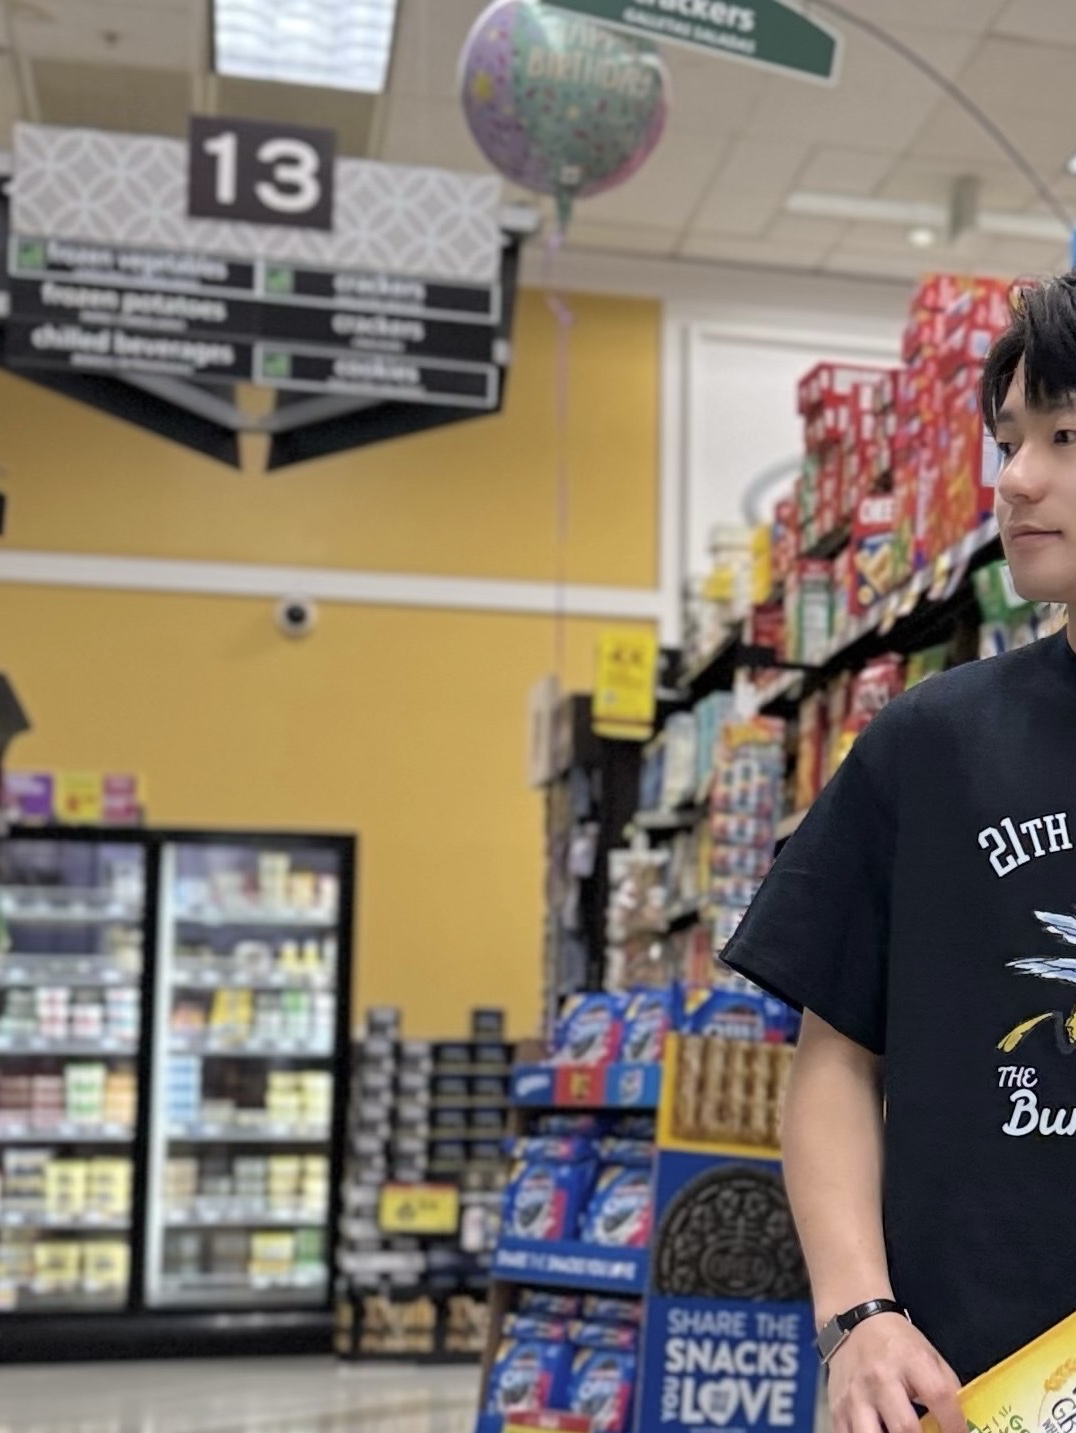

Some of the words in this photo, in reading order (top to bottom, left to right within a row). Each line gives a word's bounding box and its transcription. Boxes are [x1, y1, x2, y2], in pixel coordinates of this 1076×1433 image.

[204, 130, 322, 214] 13
[977, 812, 1073, 877] 21TH
[997, 1065, 1039, 1089] THE
[667, 1307, 748, 1338] SHARE
[754, 1312, 800, 1340] THE
[664, 1337, 799, 1377] SNACKS
[660, 1376, 681, 1423] YOU
